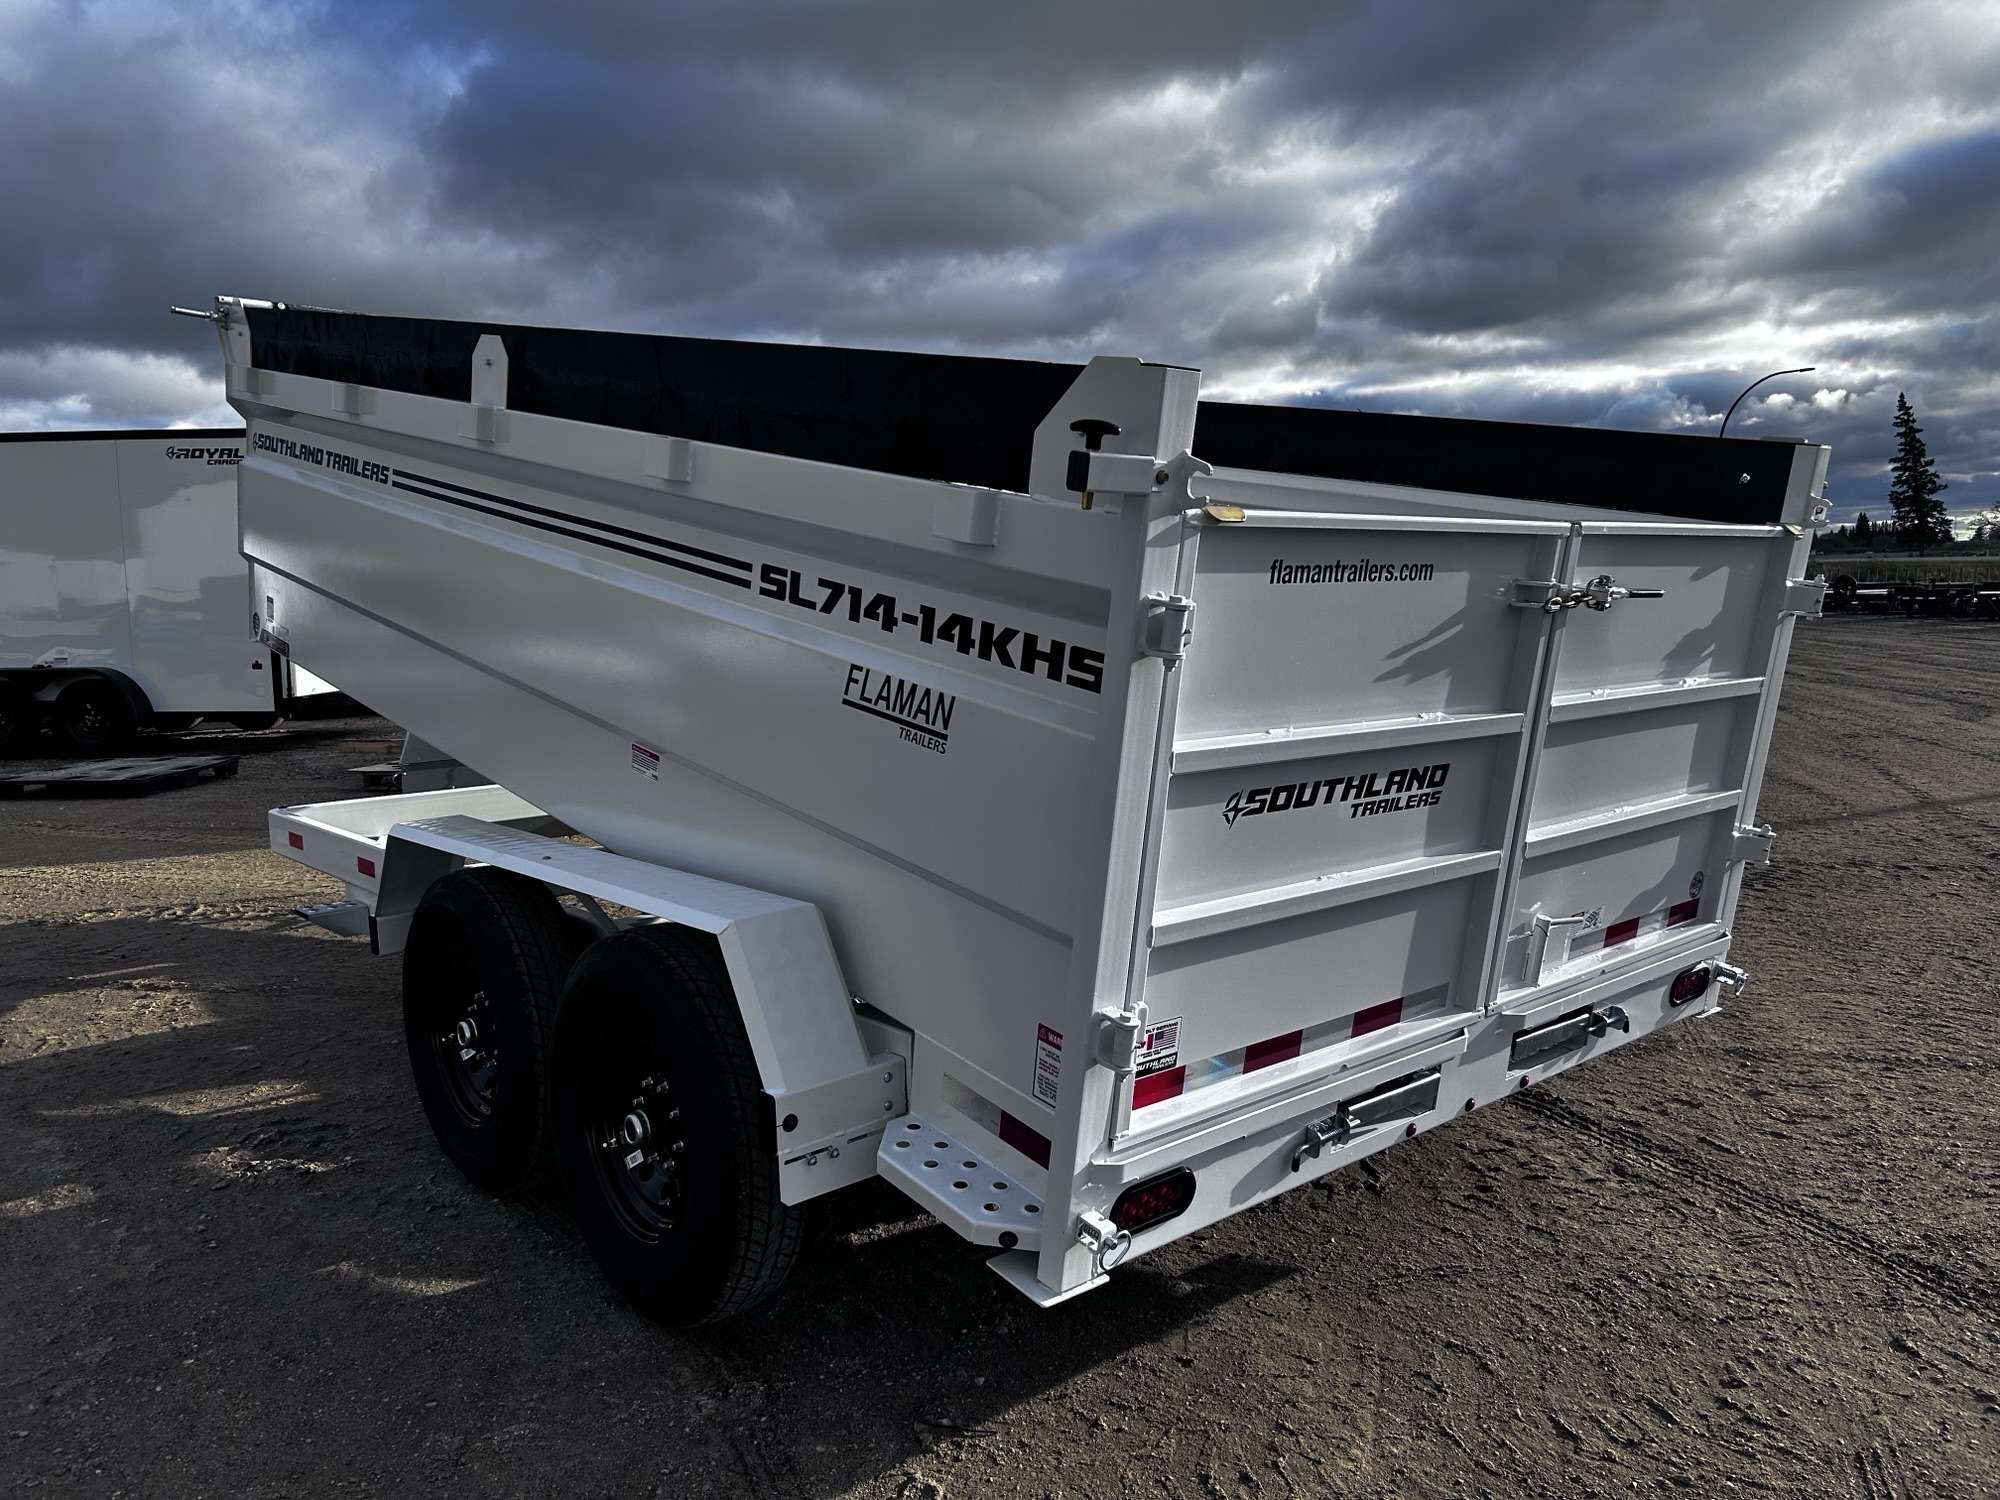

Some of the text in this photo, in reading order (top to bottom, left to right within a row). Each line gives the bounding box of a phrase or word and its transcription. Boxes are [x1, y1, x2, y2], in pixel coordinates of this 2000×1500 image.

[174, 447, 245, 459] ROYAL
[256, 433, 390, 484] SOUTHLAND TRAILERS
[1269, 558, 1435, 585] flamantrailers.com
[758, 562, 1105, 695] SL714-14KHS
[843, 663, 957, 731] FLAMAN
[898, 726, 948, 755] TRAILERS
[1240, 763, 1451, 818] SOUTHLAND
[1350, 790, 1443, 819] TRAILERS
